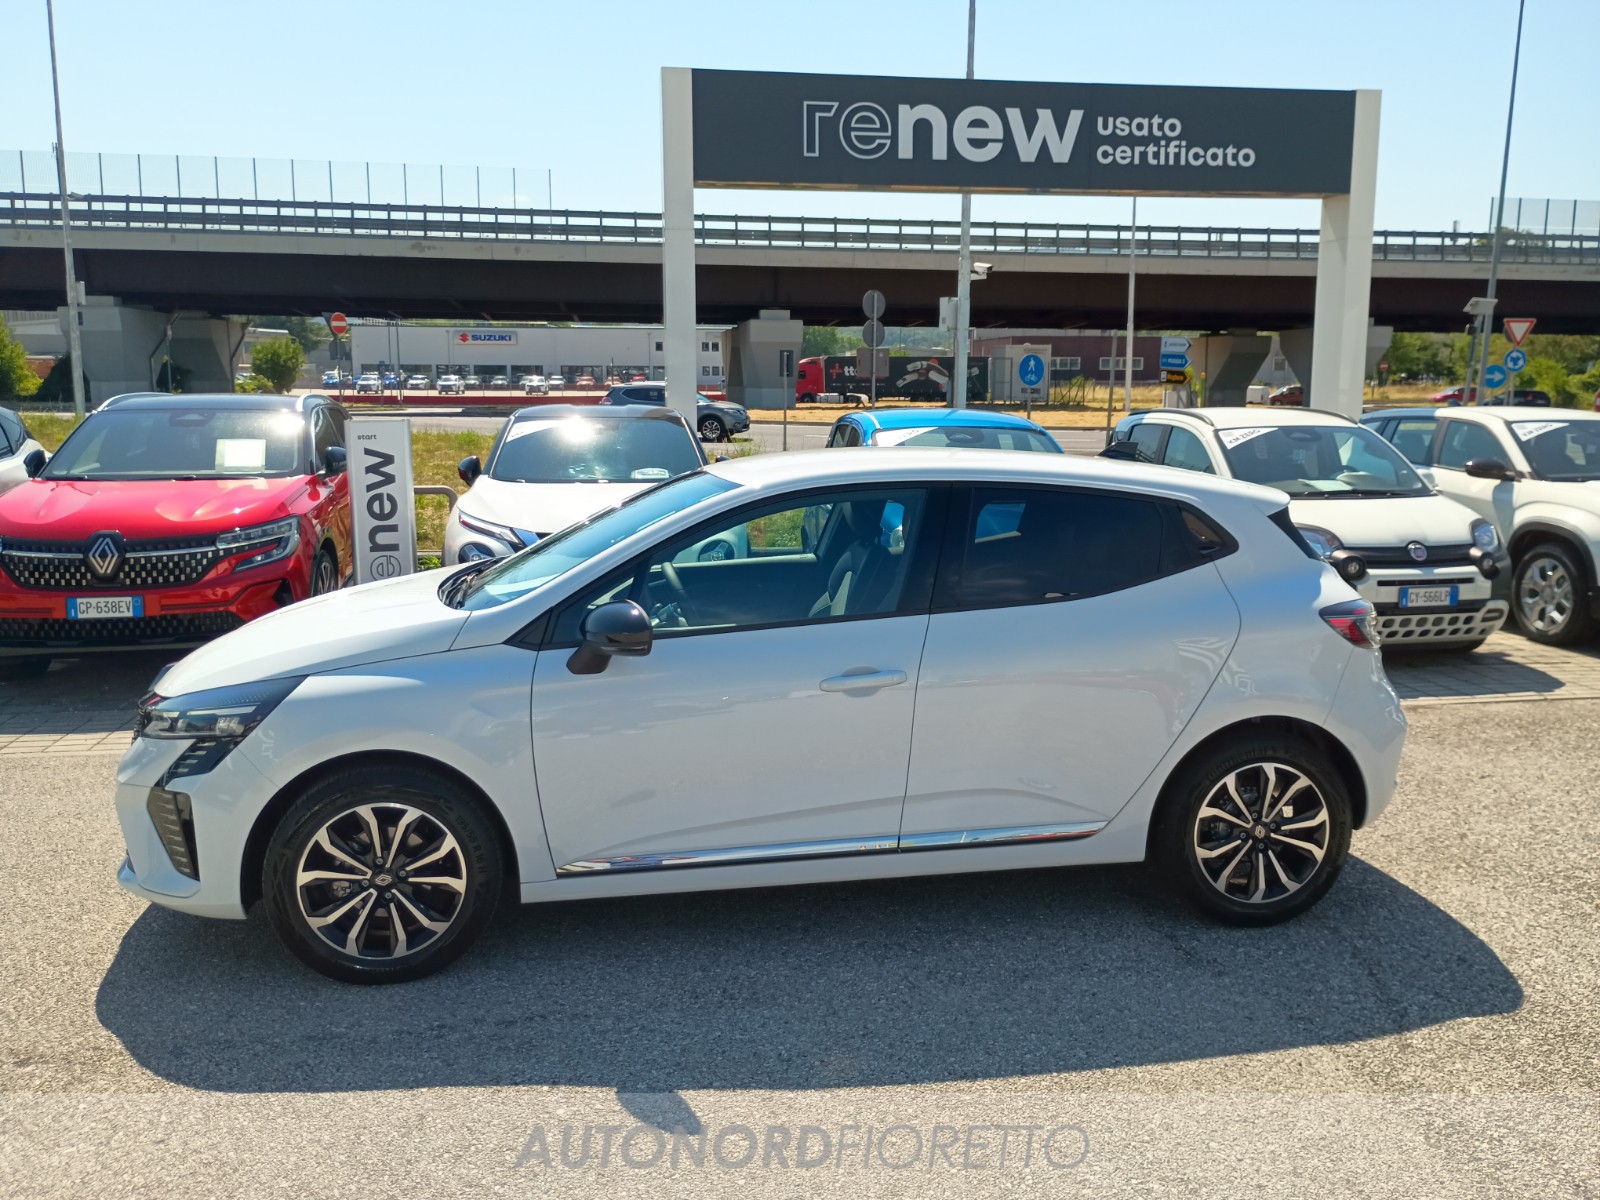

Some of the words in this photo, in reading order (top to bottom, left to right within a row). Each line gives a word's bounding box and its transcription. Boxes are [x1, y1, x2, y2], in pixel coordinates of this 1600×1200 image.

[803, 100, 1085, 164] renew
[1097, 114, 1182, 137] usato
[1096, 140, 1256, 167] certificato
[471, 334, 512, 342] SUZUKI
[1227, 435, 1241, 444] KM
[364, 447, 402, 582] enew
